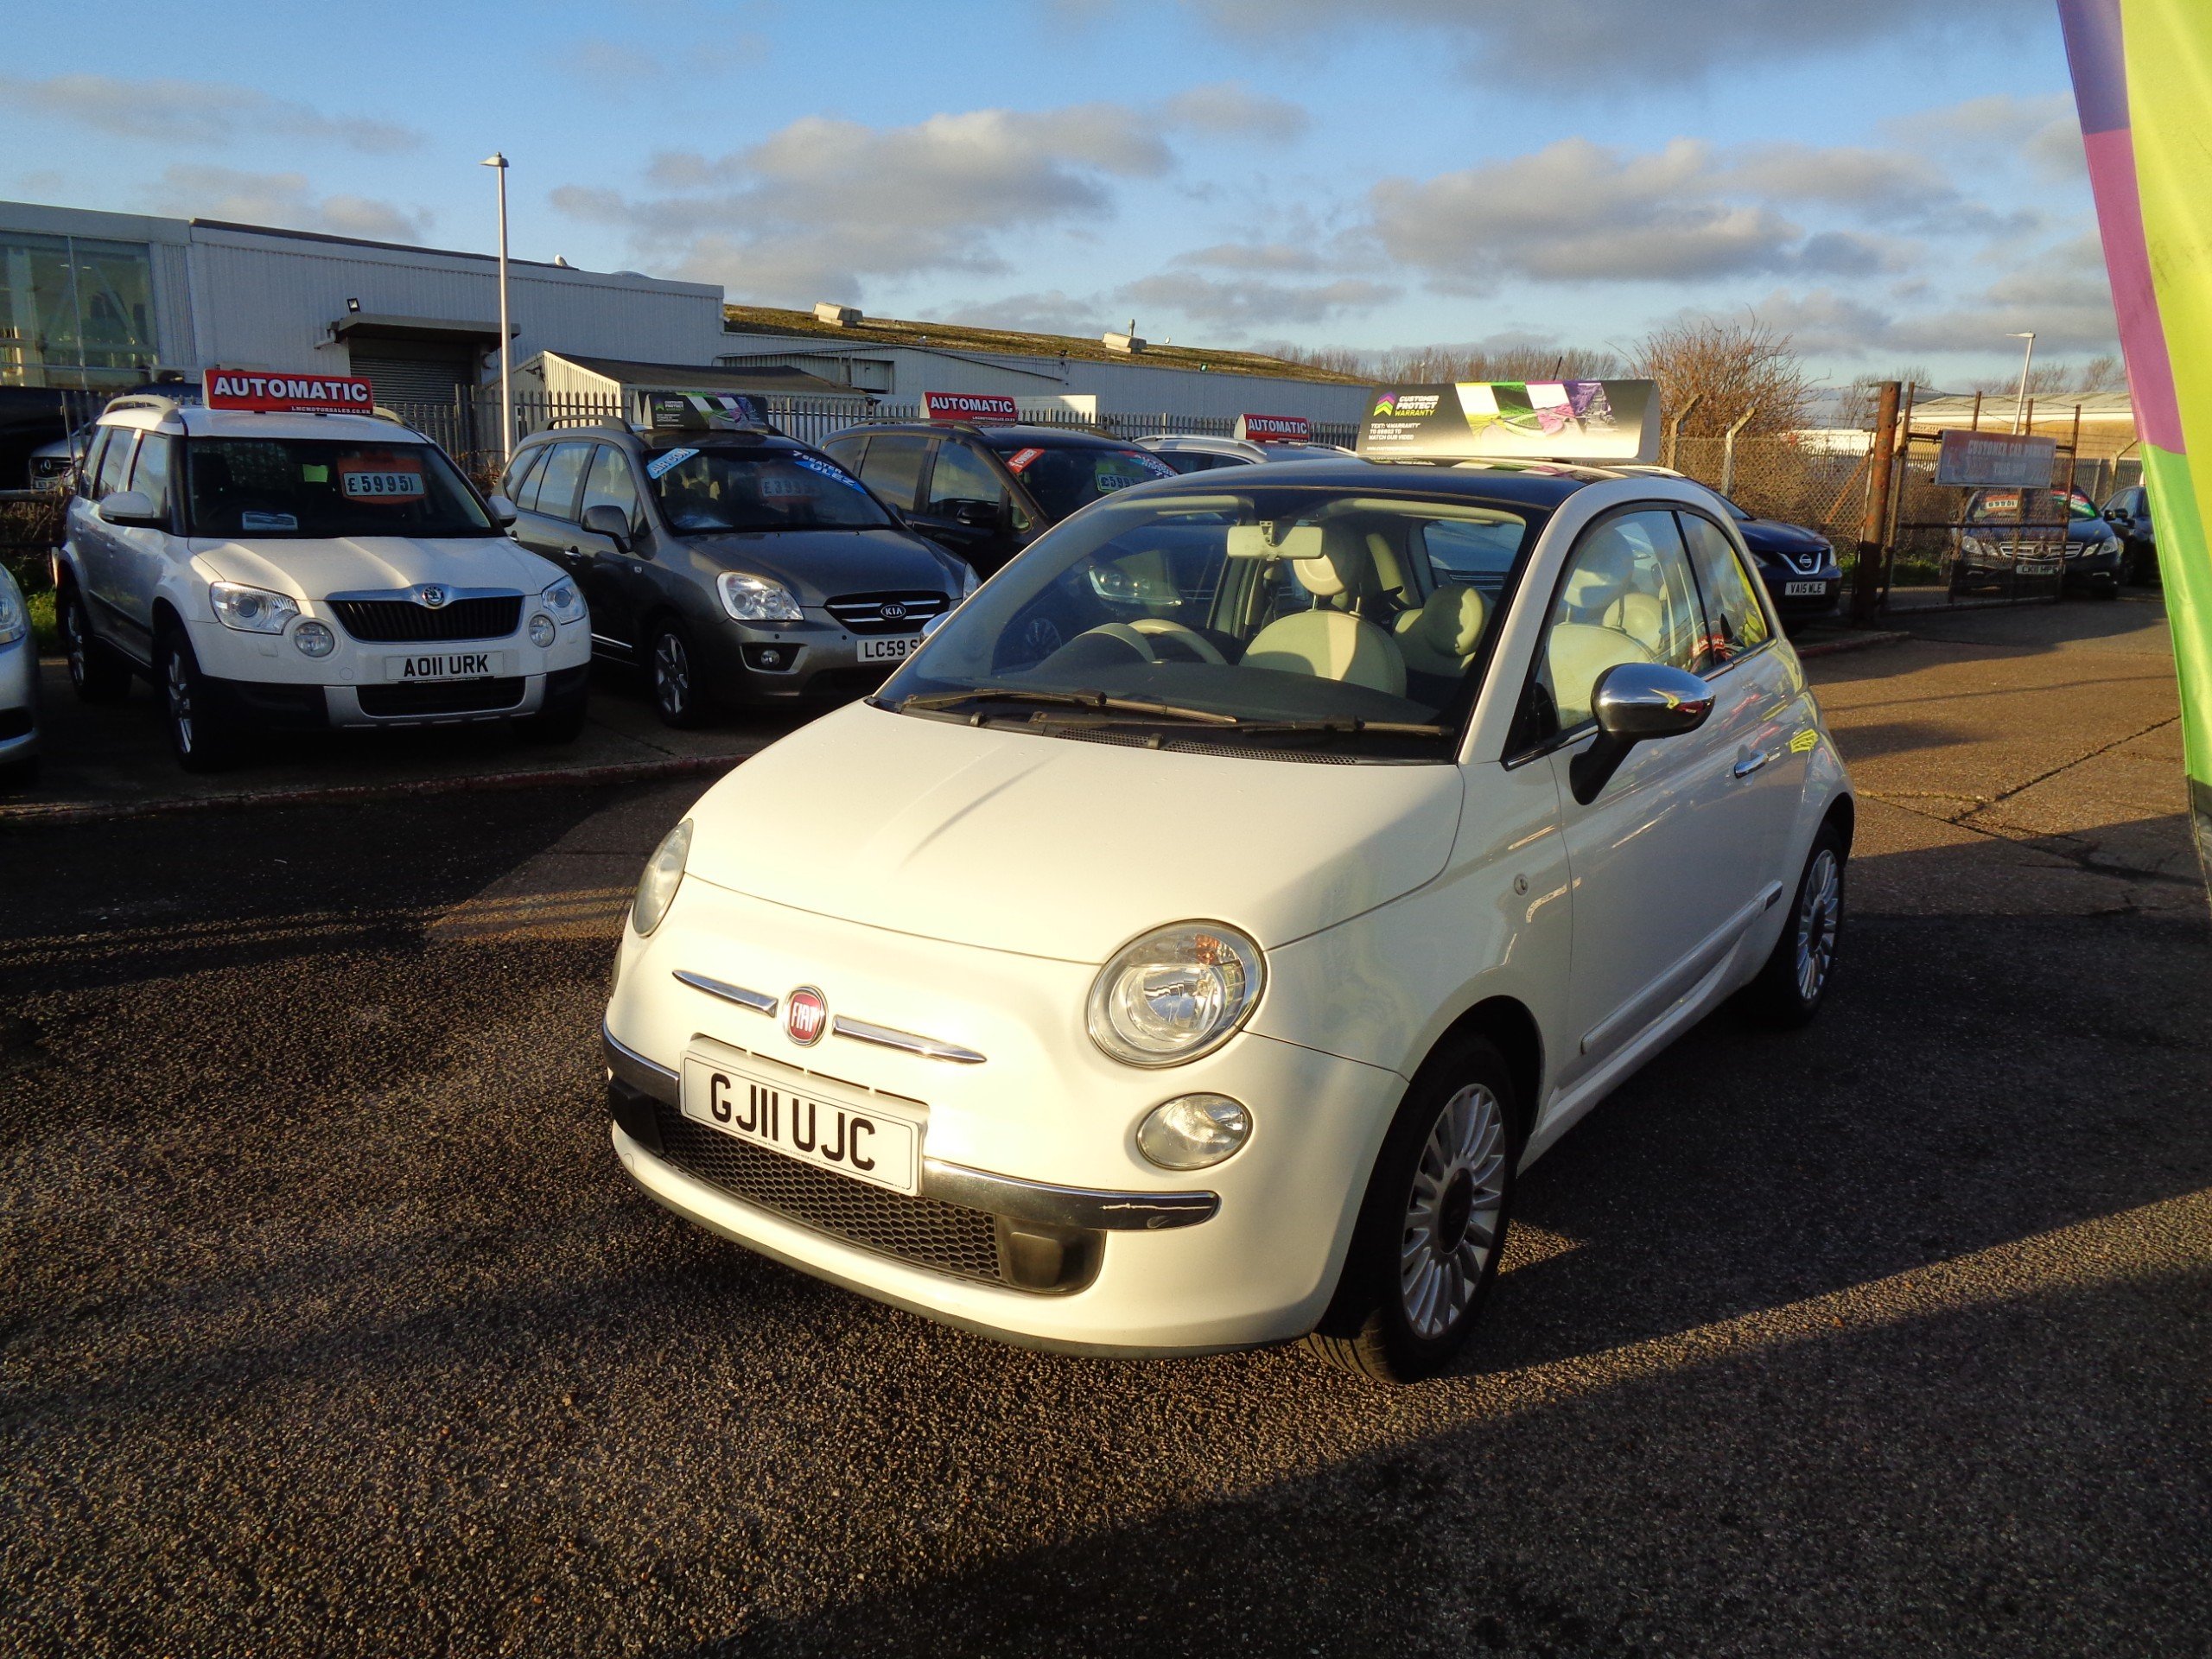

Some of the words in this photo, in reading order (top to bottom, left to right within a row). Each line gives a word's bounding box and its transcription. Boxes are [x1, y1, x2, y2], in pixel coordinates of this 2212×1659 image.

[214, 377, 368, 401] AUTOMATIC
[931, 396, 1014, 413] AUTOMATIC
[1249, 419, 1307, 434] AUTOMATIC
[1967, 440, 2008, 455] CUSTOMER
[652, 461, 670, 474] AIR
[668, 448, 692, 467] CON
[802, 454, 842, 474] SEATER
[1790, 582, 1808, 594] VA15
[865, 640, 906, 658] LC59
[449, 654, 488, 675] URK
[791, 1001, 818, 1033] FIAT
[710, 1073, 779, 1142] GJ11
[792, 1097, 875, 1172] UJC
